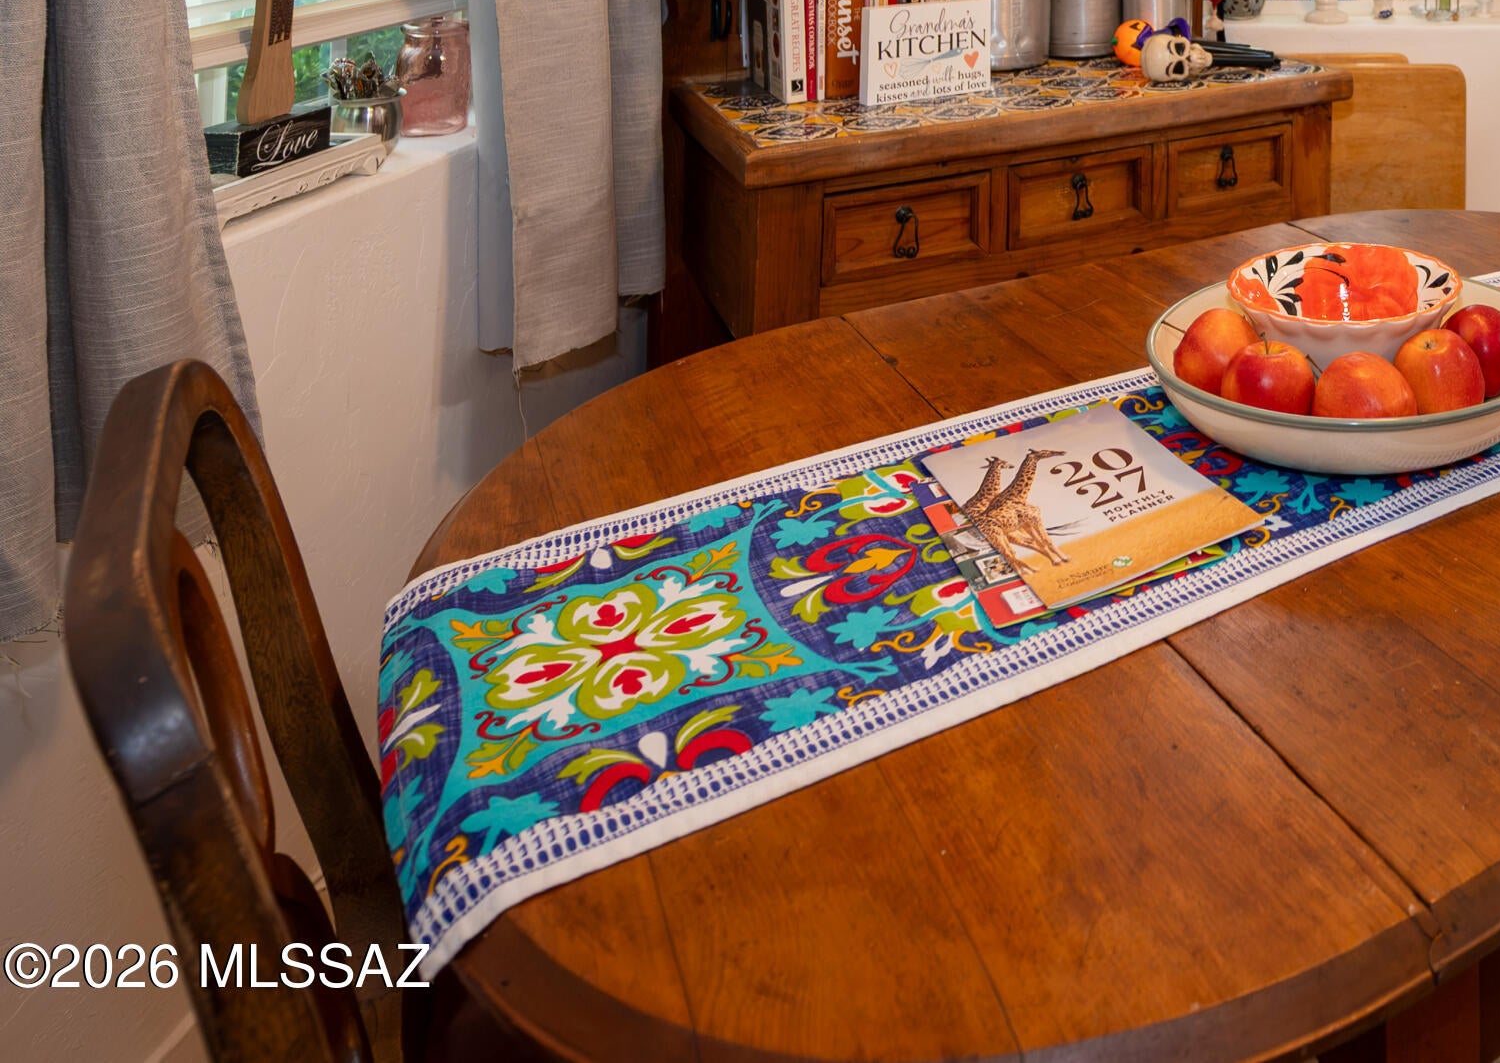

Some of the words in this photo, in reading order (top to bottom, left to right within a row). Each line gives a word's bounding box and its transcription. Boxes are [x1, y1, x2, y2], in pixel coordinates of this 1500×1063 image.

[889, 7, 976, 39] Grandma's
[791, 35, 801, 73] RECIPES
[808, 26, 816, 70] COOKBOOK
[877, 28, 986, 60] KITCHEN
[876, 92, 908, 103] kisses
[909, 87, 930, 98] and
[932, 85, 952, 95] lots
[954, 82, 965, 92] of
[967, 80, 987, 90] love
[879, 76, 929, 92] seasoned
[932, 65, 955, 84] with
[957, 69, 985, 81] hugs,
[251, 119, 319, 172] Love
[1049, 448, 1133, 487] 20
[1076, 465, 1147, 509] 27
[1102, 489, 1167, 517] MONTHLY
[1108, 494, 1175, 522] PLANNER
